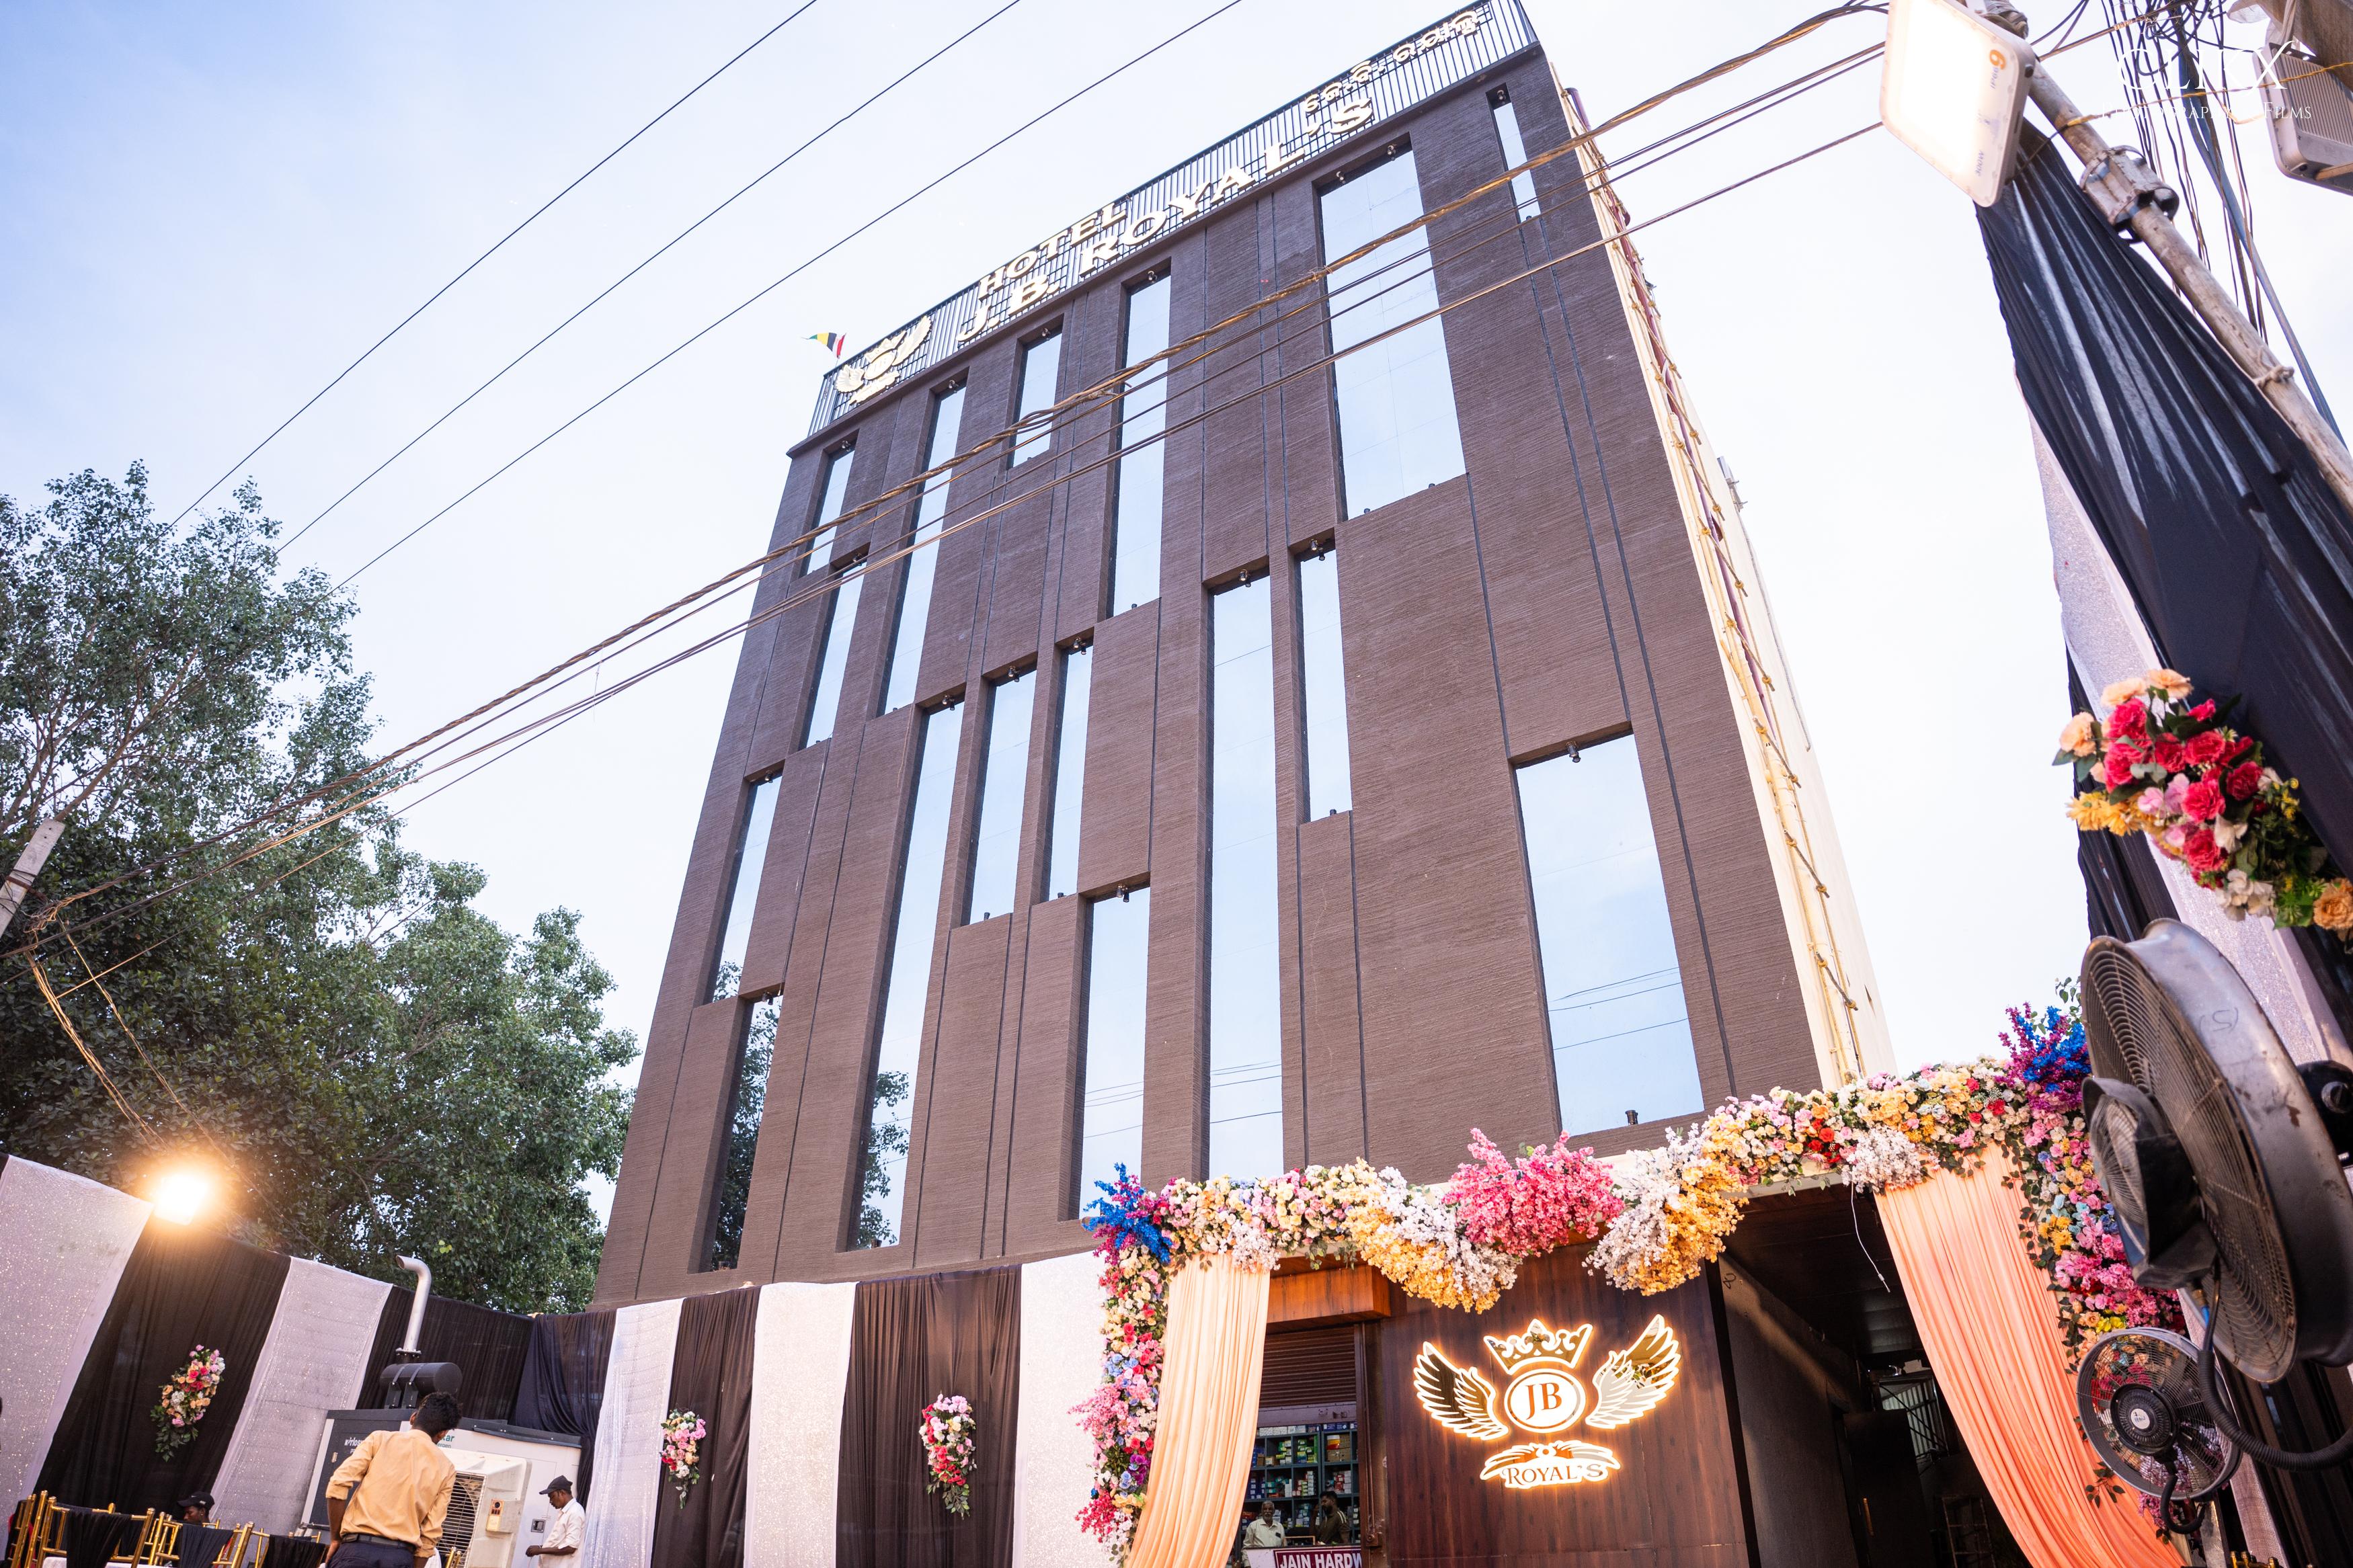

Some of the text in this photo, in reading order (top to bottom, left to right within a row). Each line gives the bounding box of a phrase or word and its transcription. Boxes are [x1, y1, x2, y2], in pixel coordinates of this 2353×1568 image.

[1078, 96, 1375, 278] ROYAL'S
[978, 202, 1129, 302] HOTEL
[1525, 1382, 1563, 1420] JB
[1501, 1463, 1604, 1487] ROYAL'S
[1280, 1553, 1312, 1568] JAIN
